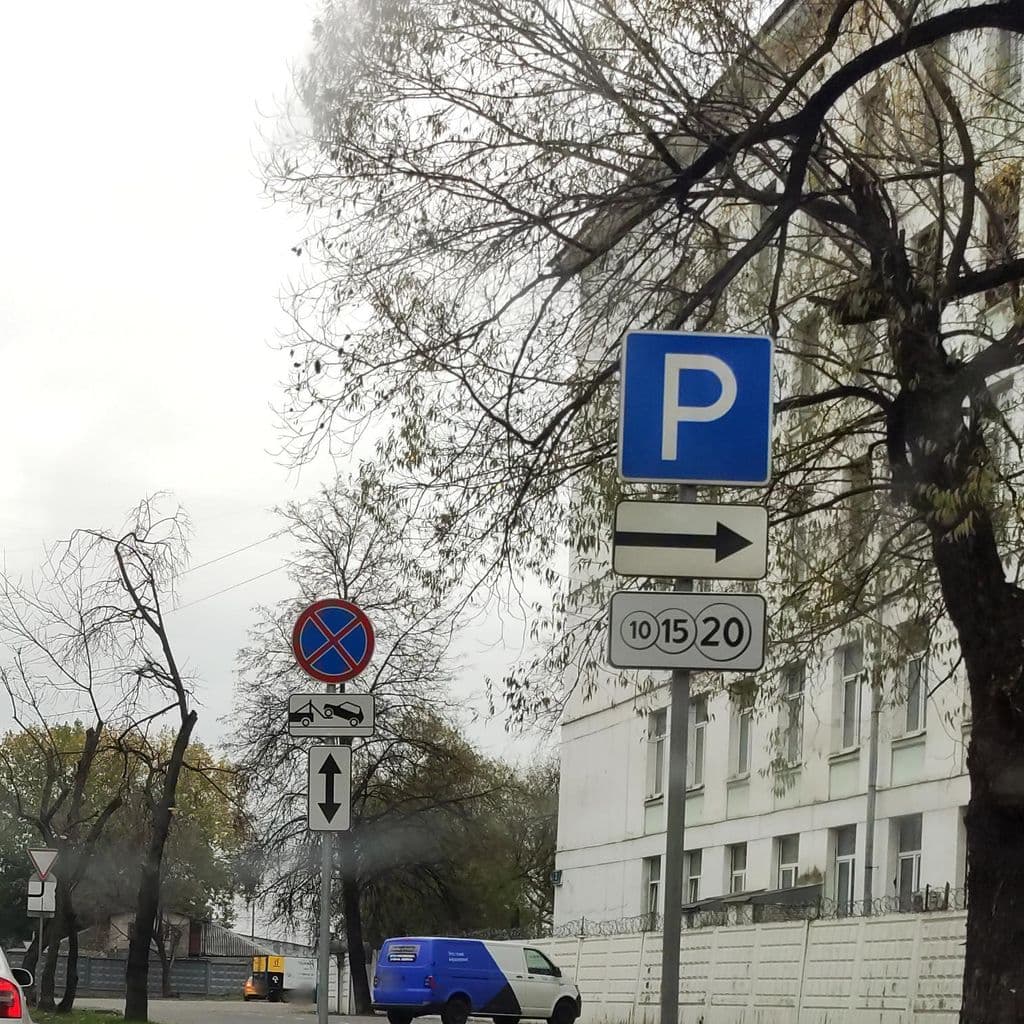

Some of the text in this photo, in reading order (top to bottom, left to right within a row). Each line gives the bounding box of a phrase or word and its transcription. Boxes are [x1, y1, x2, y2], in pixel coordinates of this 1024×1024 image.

[661, 353, 738, 461] P
[629, 616, 744, 647] 10 15 20
